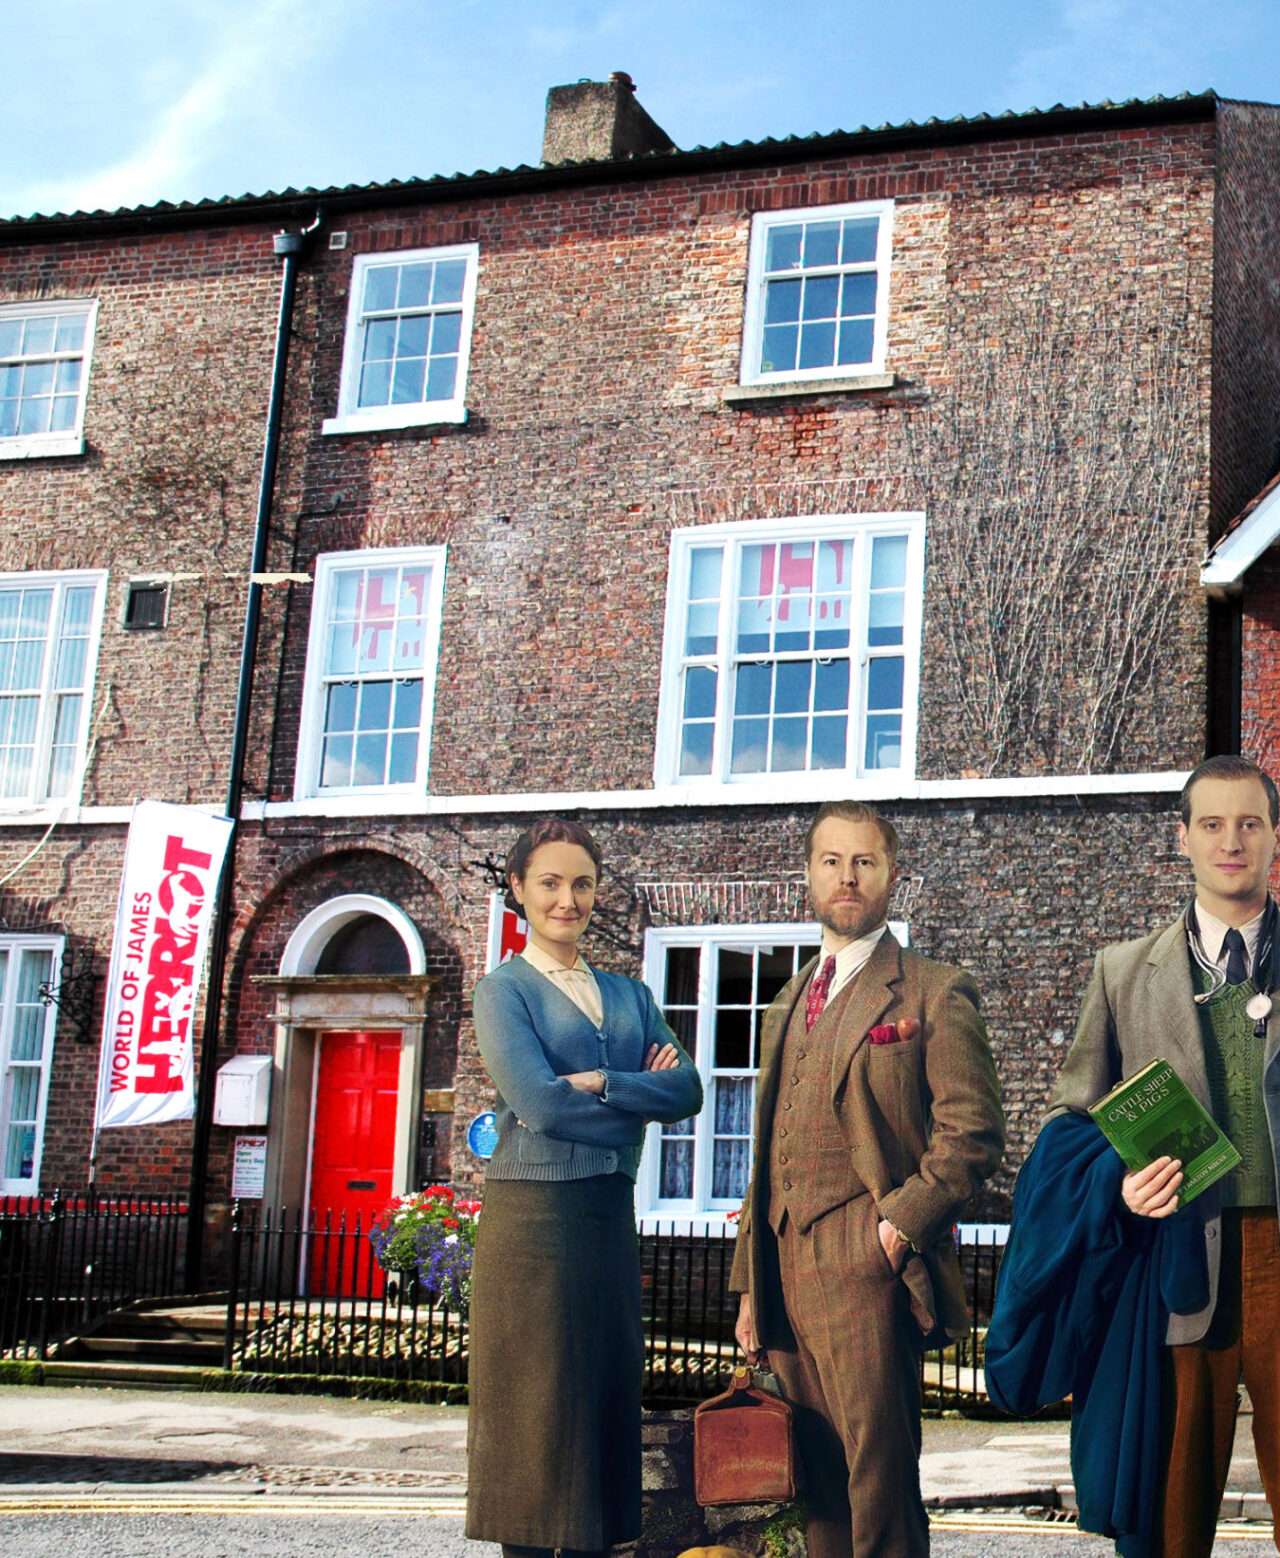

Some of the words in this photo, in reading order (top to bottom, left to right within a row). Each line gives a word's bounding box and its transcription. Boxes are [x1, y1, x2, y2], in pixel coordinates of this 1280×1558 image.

[126, 892, 152, 964] JAMES
[121, 970, 140, 999] OF
[134, 834, 212, 1094] HERRIOT
[110, 1010, 135, 1093] WORLD
[1108, 1089, 1146, 1122] CATTLE
[1143, 1068, 1174, 1096] SHEEP
[1126, 1111, 1139, 1122] &
[1138, 1086, 1170, 1113] PIGS
